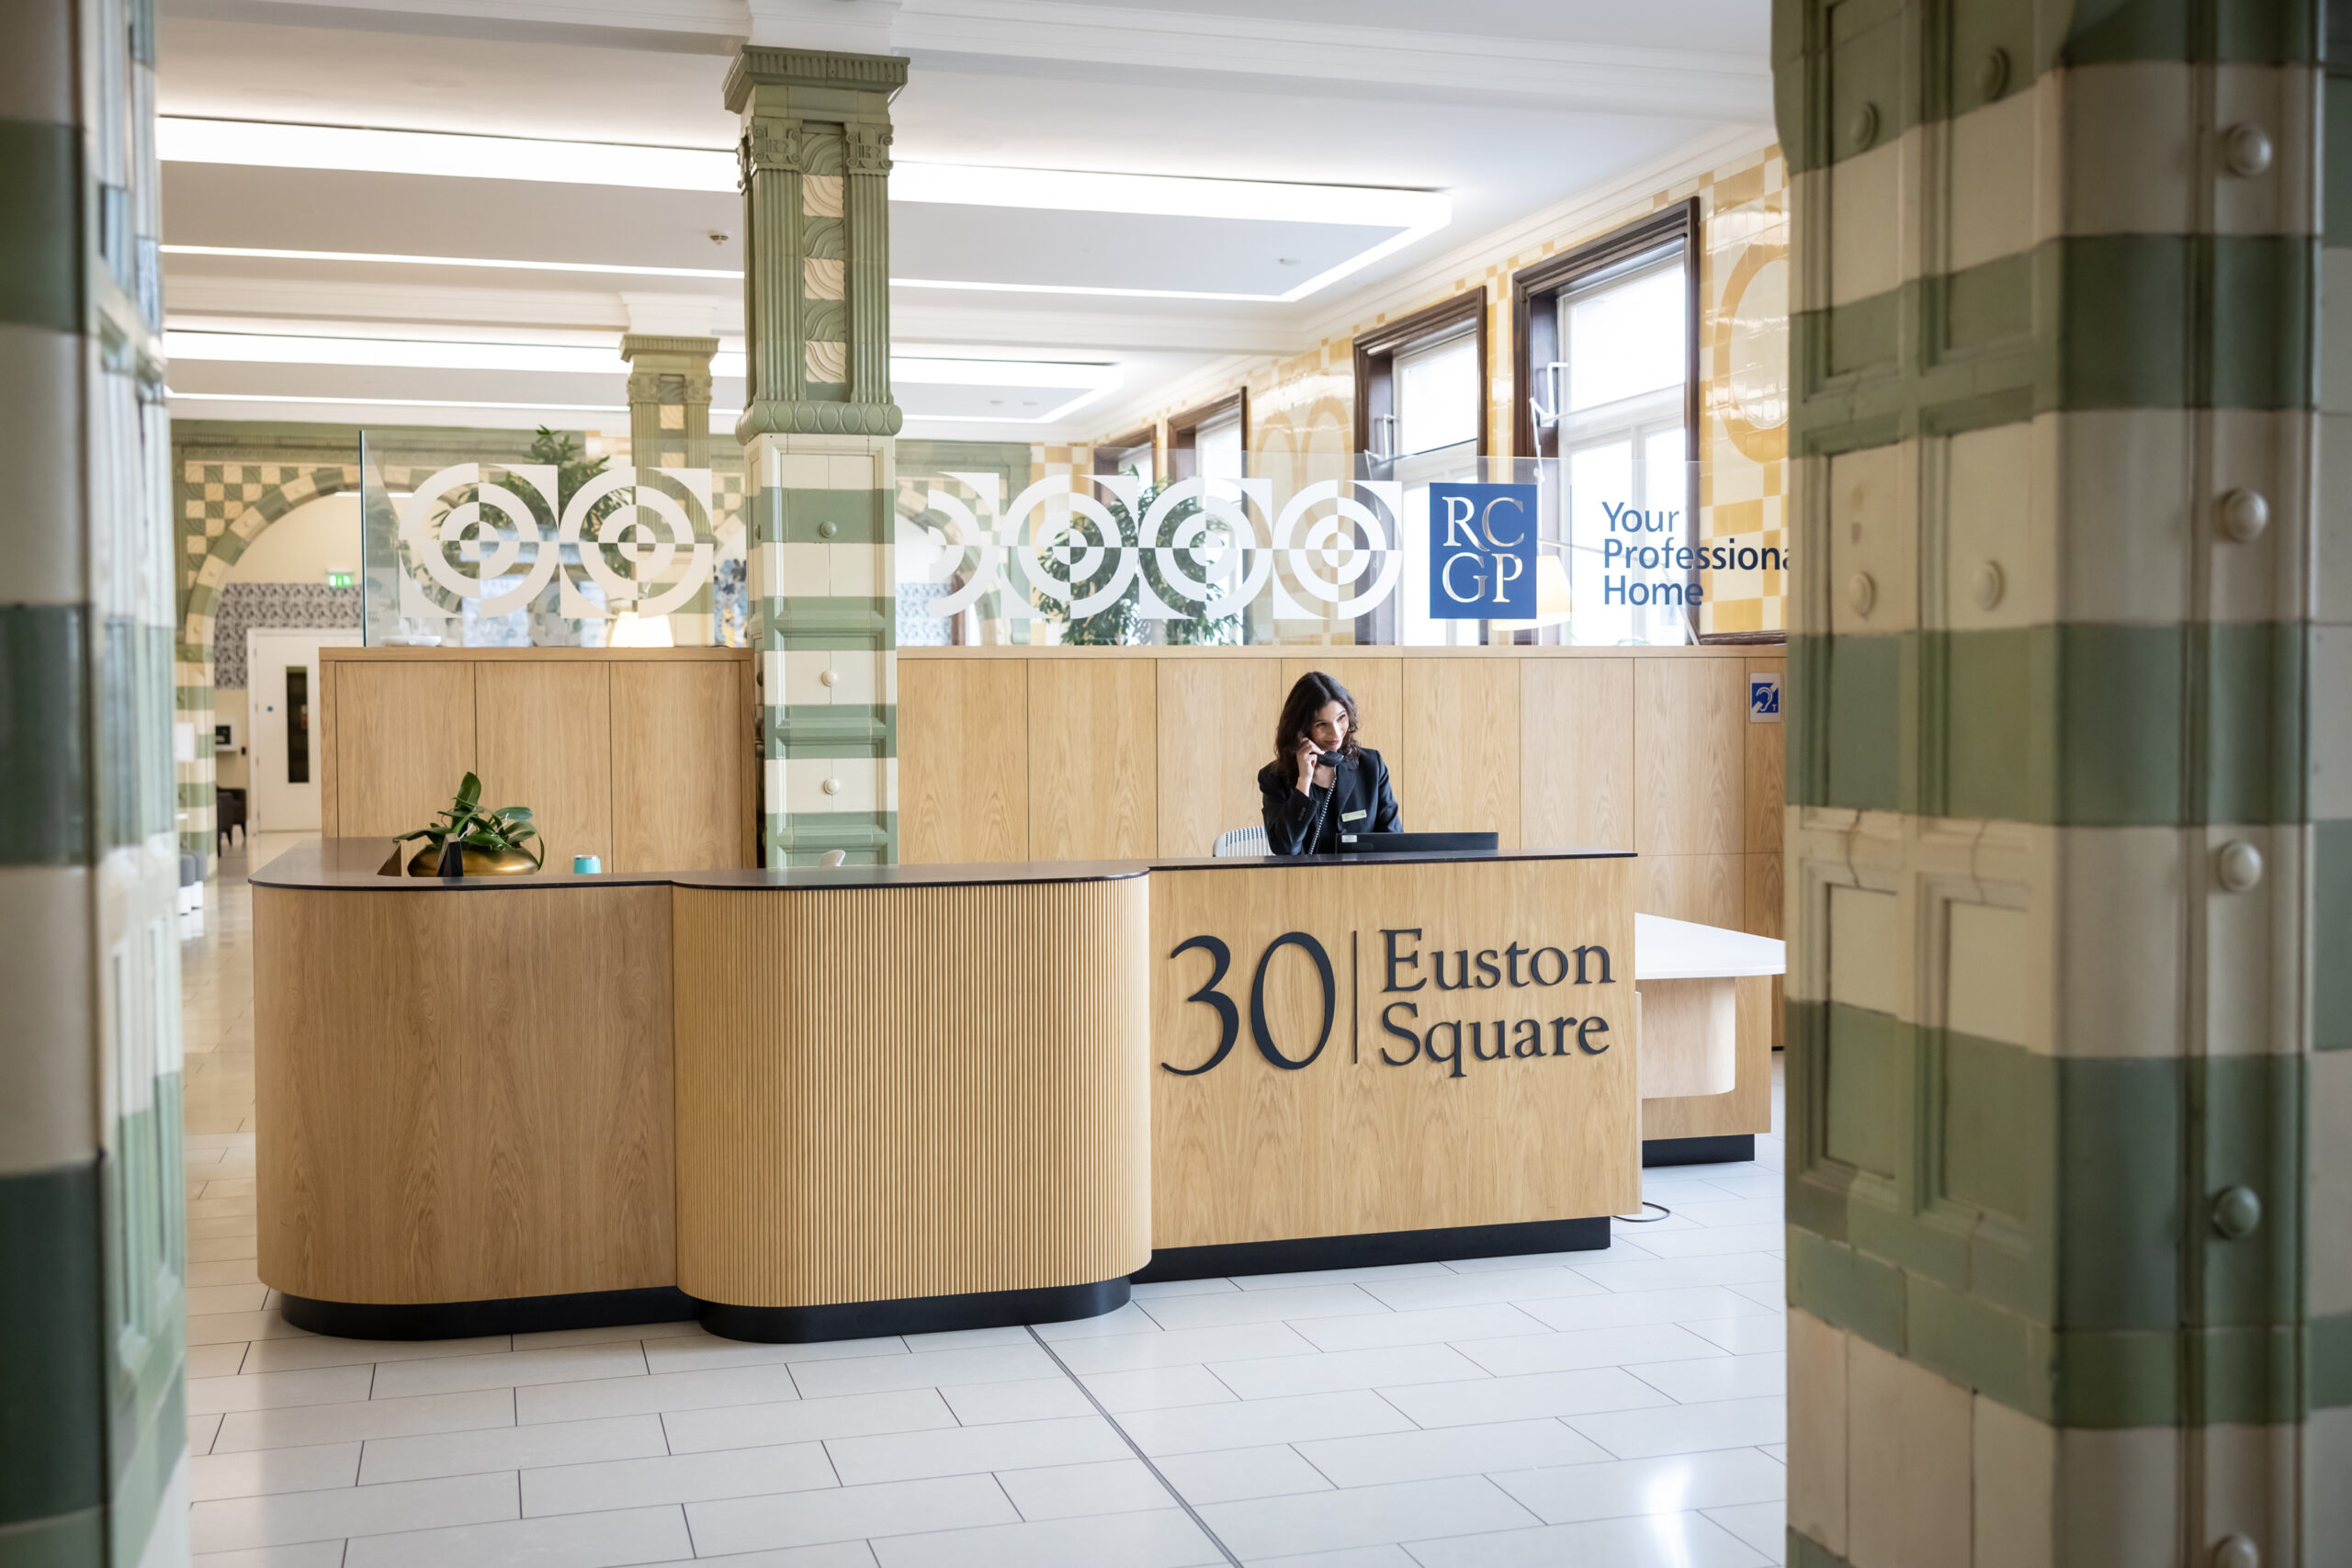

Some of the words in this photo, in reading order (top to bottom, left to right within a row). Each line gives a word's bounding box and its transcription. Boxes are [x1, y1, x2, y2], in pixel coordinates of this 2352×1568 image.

[1442, 496, 1525, 551] RC
[1601, 502, 1679, 532] Your
[1442, 552, 1523, 604] GP
[1604, 575, 1704, 606] Home
[1379, 928, 1617, 993] Euston
[1161, 931, 1336, 1076] 30
[1381, 1000, 1611, 1078] Square
